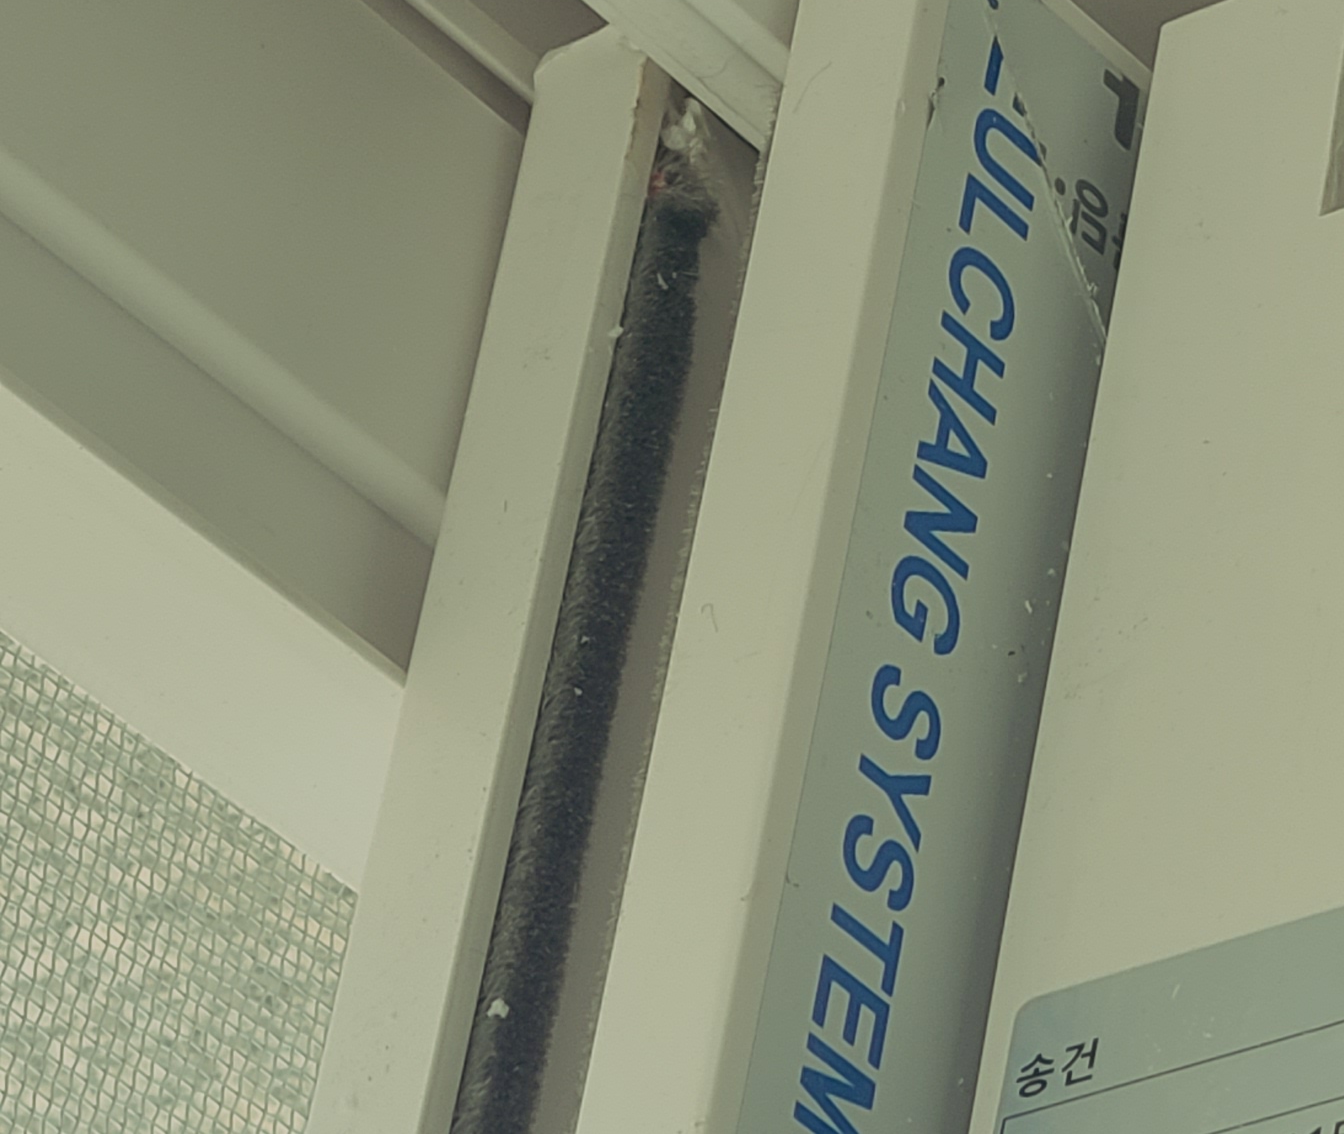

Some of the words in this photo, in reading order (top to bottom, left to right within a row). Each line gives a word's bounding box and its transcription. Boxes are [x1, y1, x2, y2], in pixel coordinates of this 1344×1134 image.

[891, 34, 1037, 657] ULCHANG
[793, 664, 942, 1134] SYSTEM
[1015, 1037, 1100, 1098] 송건
